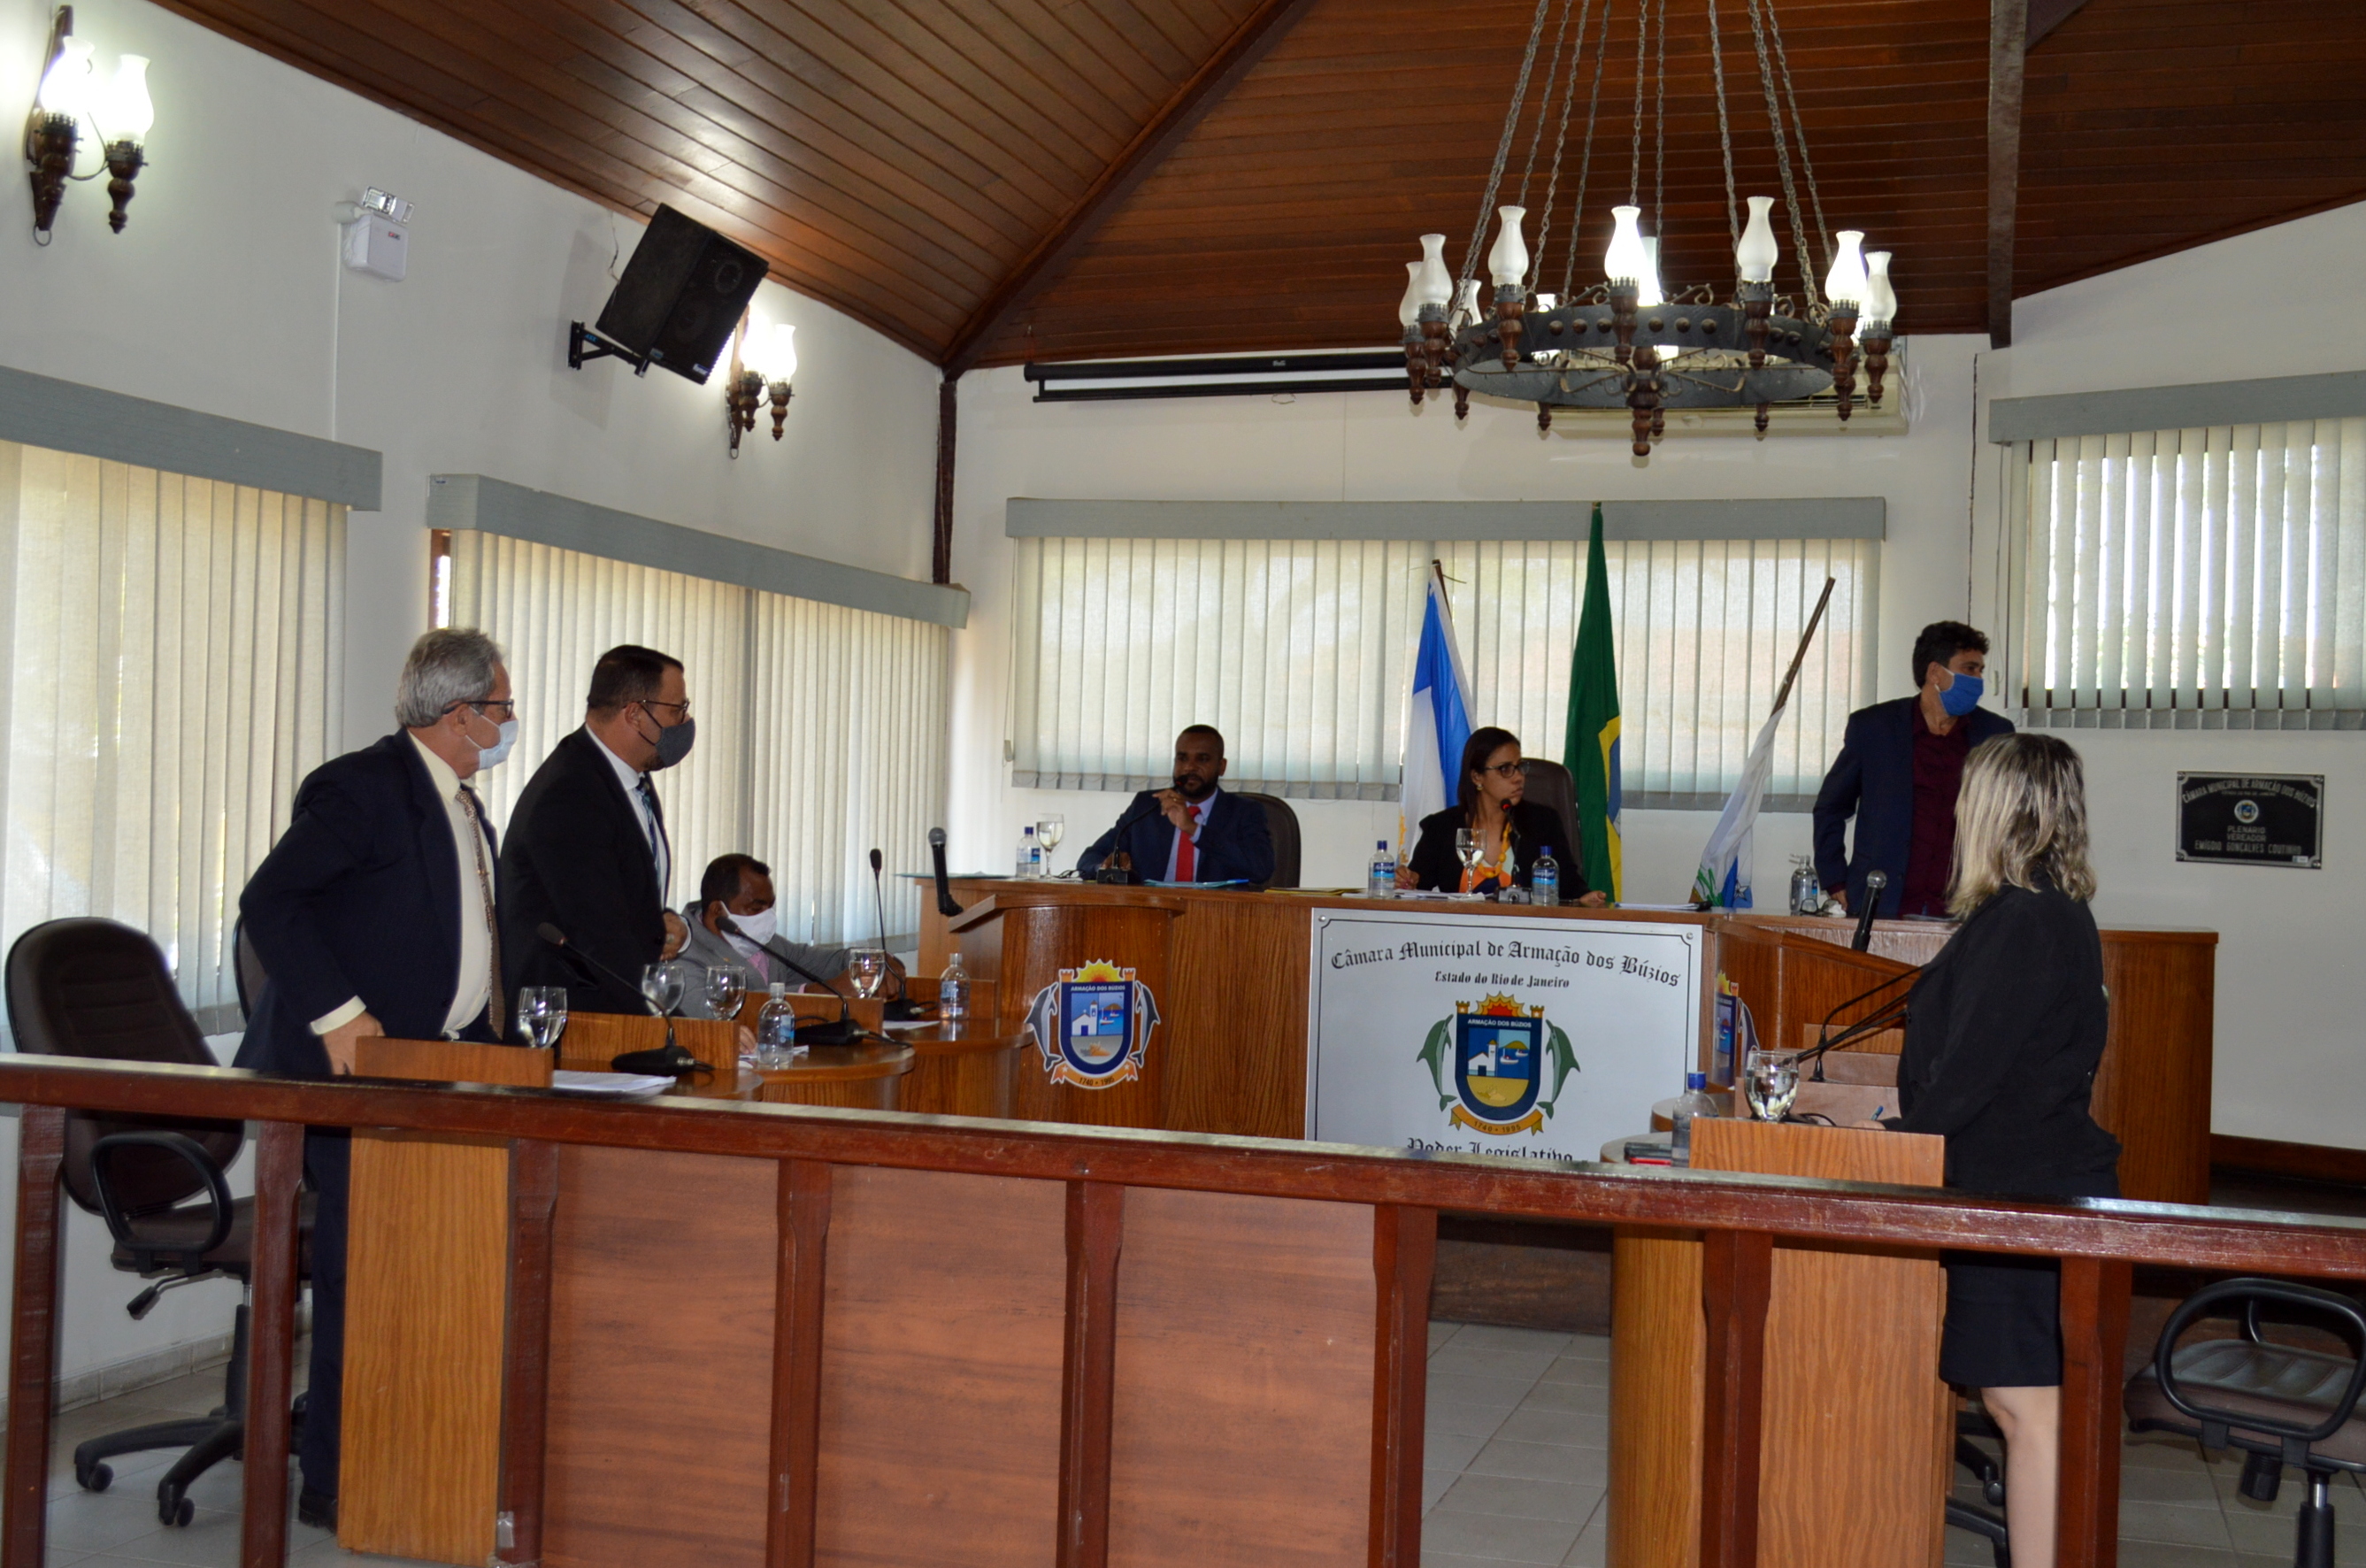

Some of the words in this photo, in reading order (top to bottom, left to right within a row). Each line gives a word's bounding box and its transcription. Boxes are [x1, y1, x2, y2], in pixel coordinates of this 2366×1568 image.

[2226, 833, 2267, 842] VEREADOR
[1331, 948, 1394, 970] Câmara
[1398, 940, 1481, 960] Municipal
[1487, 941, 1504, 957] de
[1508, 941, 1580, 967] Armação
[1586, 950, 1615, 970] dos
[1619, 955, 1681, 987] Búzios
[1435, 971, 1471, 983] Estado
[1474, 972, 1487, 984] do
[1491, 973, 1509, 986] Rio
[1510, 974, 1524, 986] de
[1526, 974, 1570, 988] Janeiro
[1510, 1019, 1532, 1028] BÚZIOS
[1473, 1120, 1493, 1132] 1740
[1502, 1123, 1521, 1133] 1995
